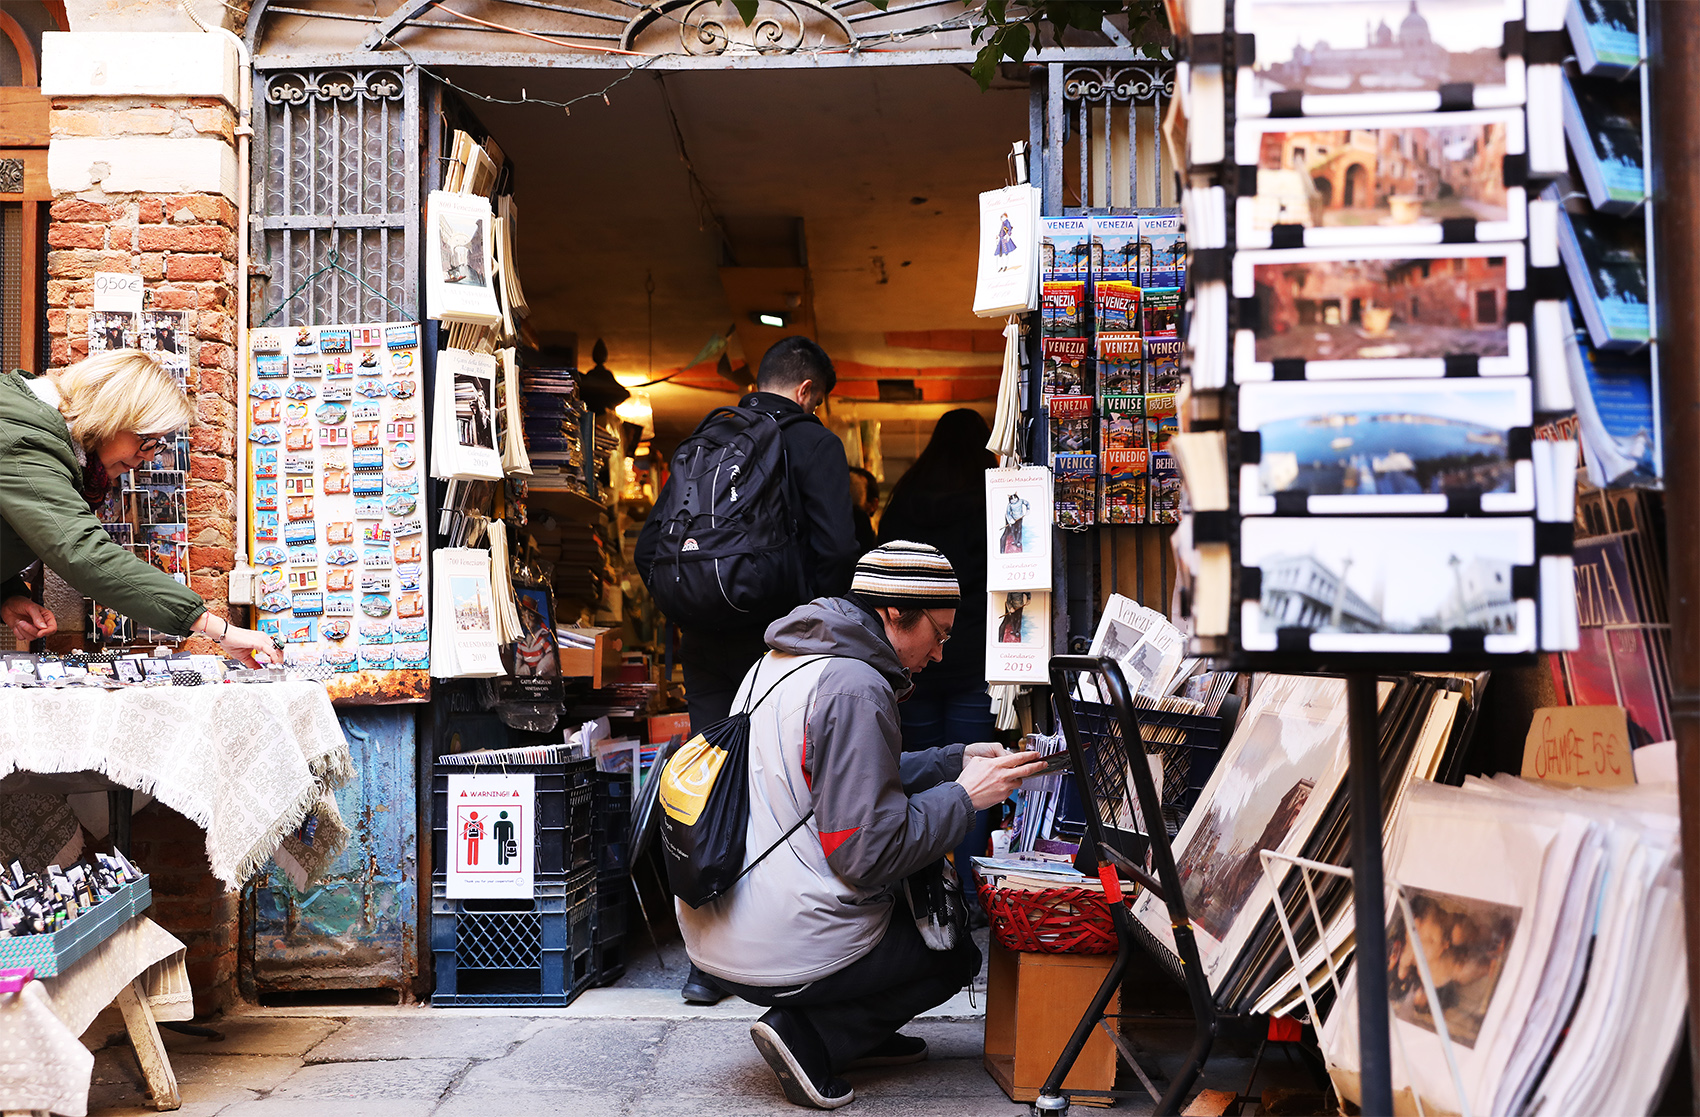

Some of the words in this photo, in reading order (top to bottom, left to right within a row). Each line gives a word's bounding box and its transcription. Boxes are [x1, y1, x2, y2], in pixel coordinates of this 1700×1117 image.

[1047, 221, 1084, 229] VENEZIA
[1097, 221, 1134, 229] VENEZIA
[1044, 294, 1076, 307] VENEZIA
[1106, 296, 1135, 311] VENEZIA
[1048, 341, 1085, 353] VENEZIA
[1105, 342, 1139, 353] VENEZA
[1150, 342, 1186, 355] VENECIA
[1052, 400, 1089, 411] VENEZIA
[1107, 398, 1142, 410] VENISE
[1149, 397, 1177, 410] 威尼
[473, 458, 489, 467] 2019
[1060, 457, 1094, 469] VENICE
[1109, 451, 1146, 463] VENEDIG
[1006, 571, 1035, 581] 2019
[1117, 600, 1153, 632] Venezi
[457, 641, 495, 649] CALENDARIO
[472, 653, 487, 662] 2019
[1004, 661, 1033, 672] 2019
[1535, 716, 1590, 779] STAMPE
[1593, 732, 1621, 775] 5€
